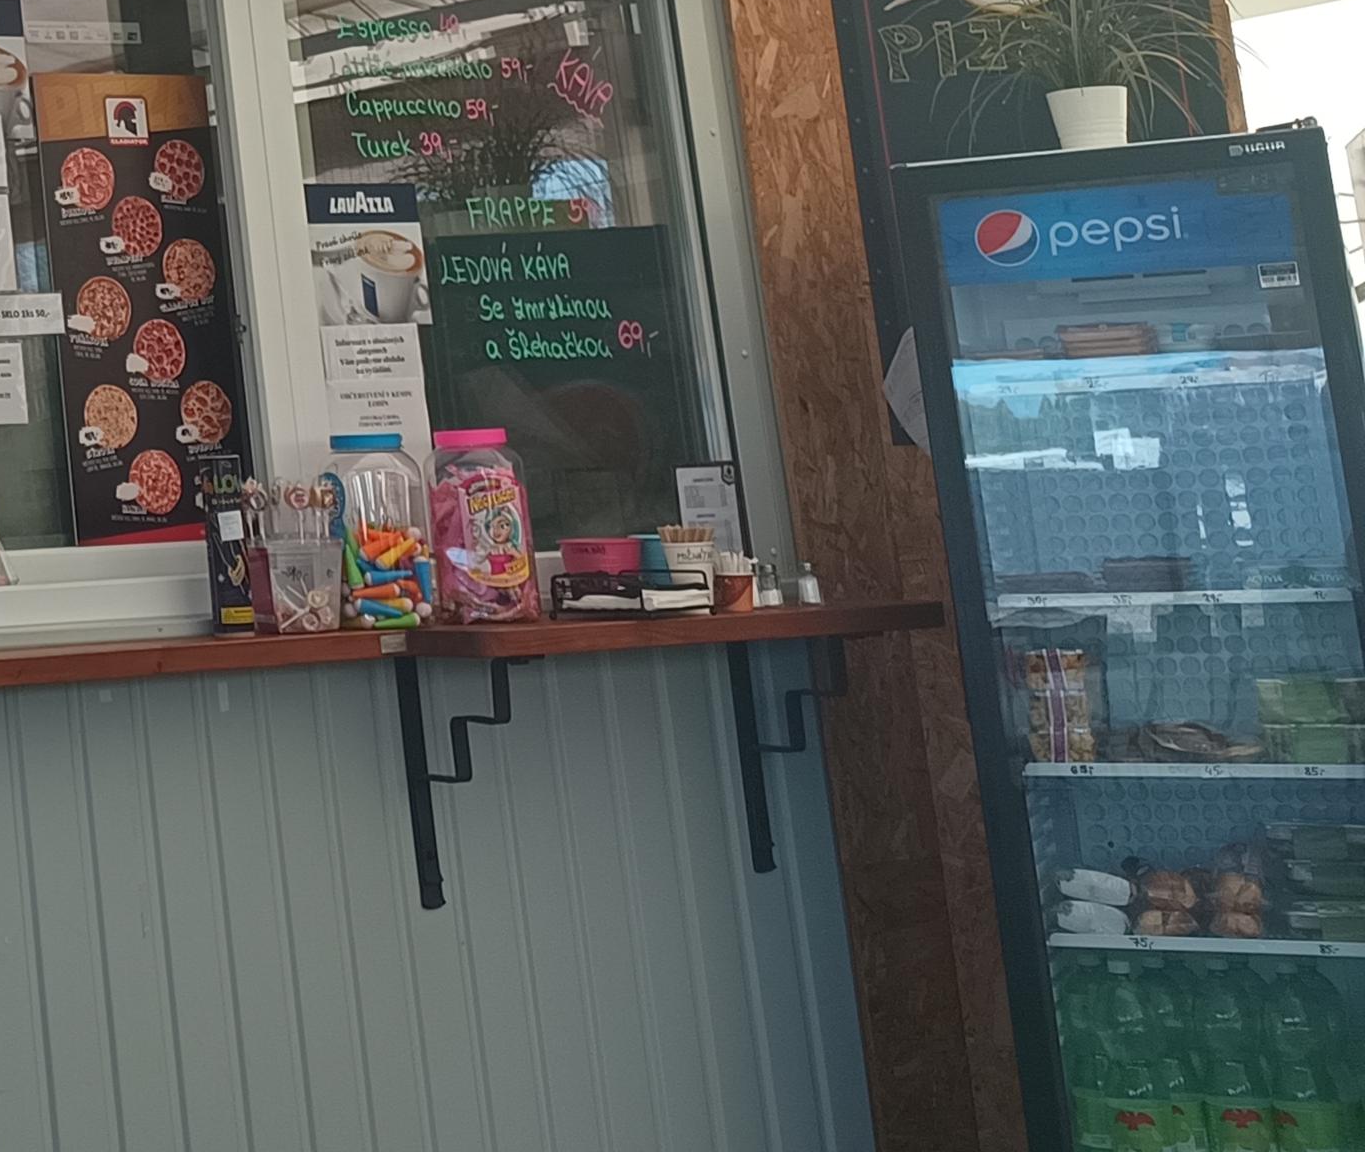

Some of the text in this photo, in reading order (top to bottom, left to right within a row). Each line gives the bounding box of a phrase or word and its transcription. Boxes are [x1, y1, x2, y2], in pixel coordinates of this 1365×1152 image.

[500, 56, 534, 82] 59,-
[345, 91, 499, 127] Cappuccino 59,-
[351, 132, 458, 163] Turek 39,-
[329, 191, 394, 215] LAVAZZA
[466, 197, 556, 229] FRAPPE
[1048, 206, 1183, 257] pepsi
[441, 242, 570, 286] LEDOVÁ KÁVA
[511, 296, 612, 322] zmrzlinou
[509, 320, 660, 361] šlehačkou 69,-
